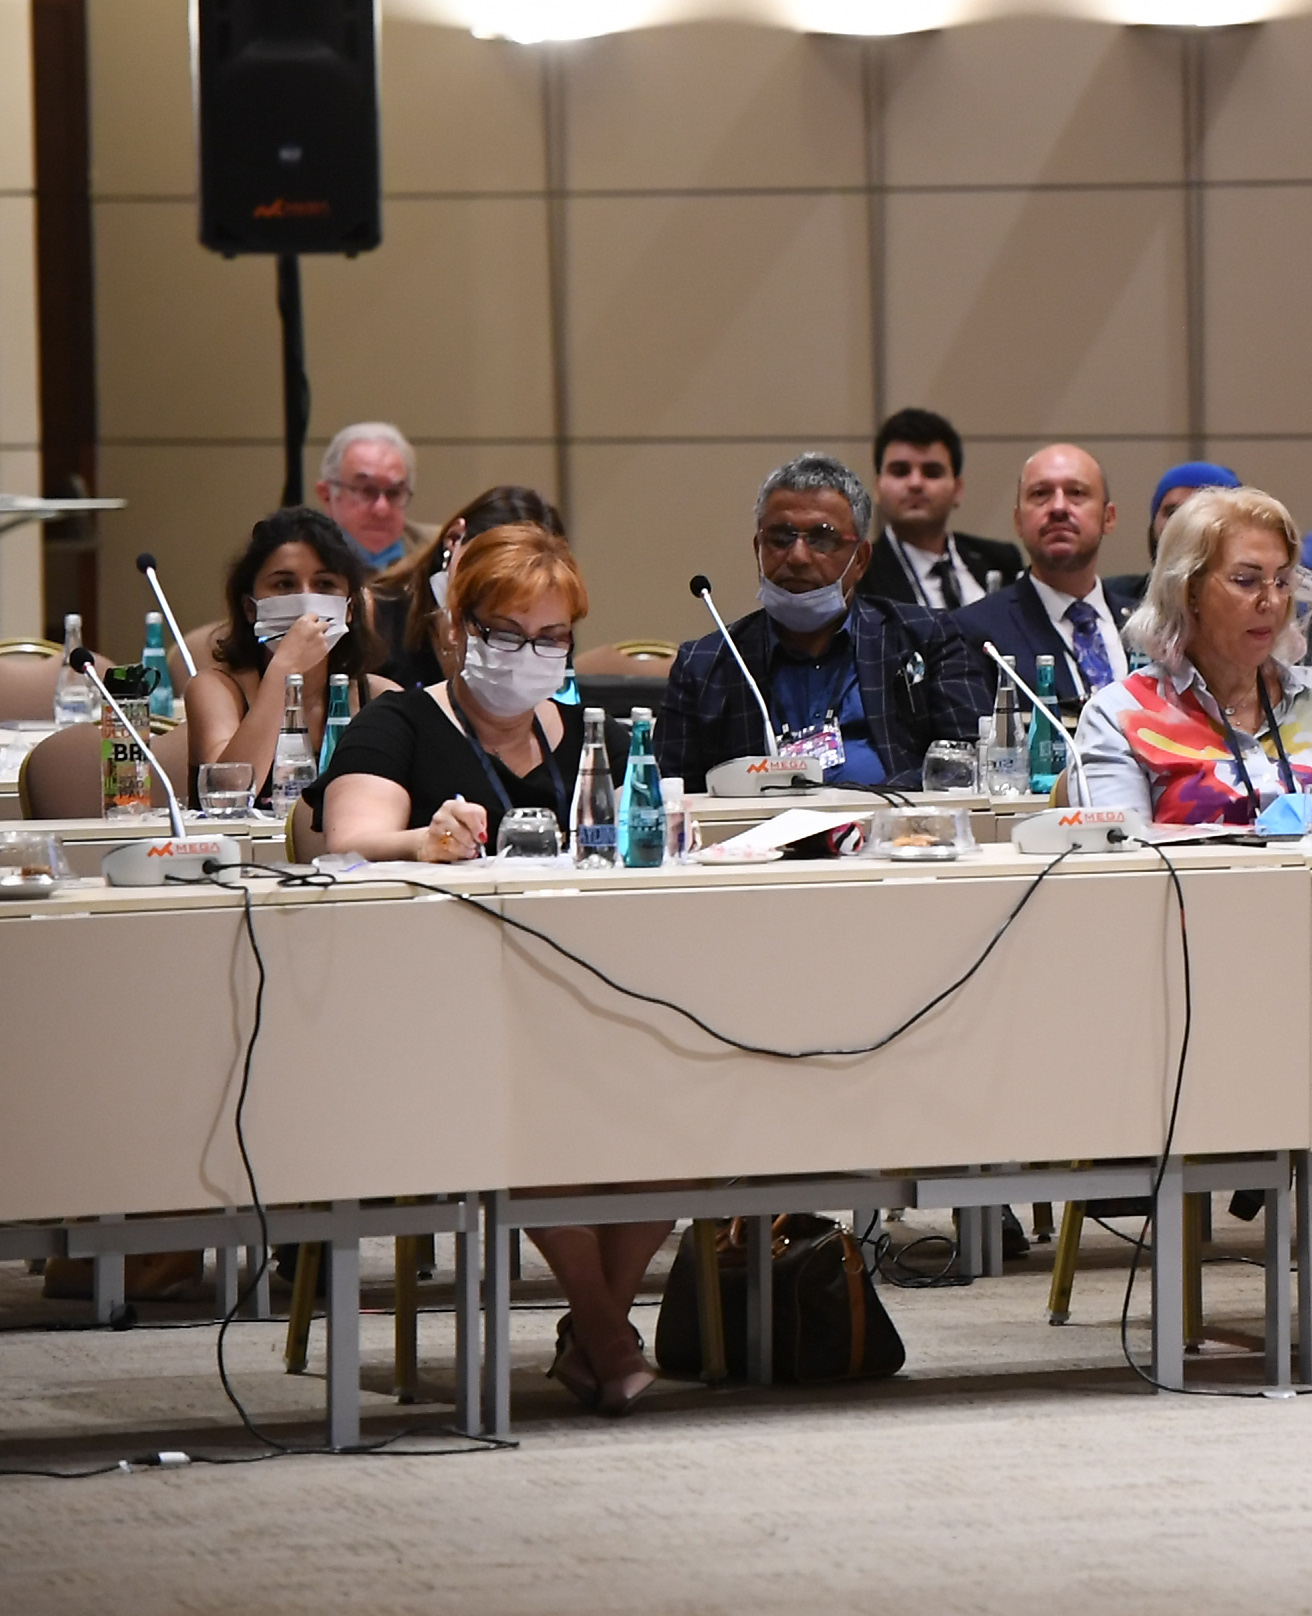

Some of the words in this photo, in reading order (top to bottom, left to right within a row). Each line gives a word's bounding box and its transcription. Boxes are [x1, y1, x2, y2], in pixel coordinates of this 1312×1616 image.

[769, 760, 807, 771] MEGA
[1083, 811, 1126, 823] MEGA
[176, 842, 221, 855] MEGA
